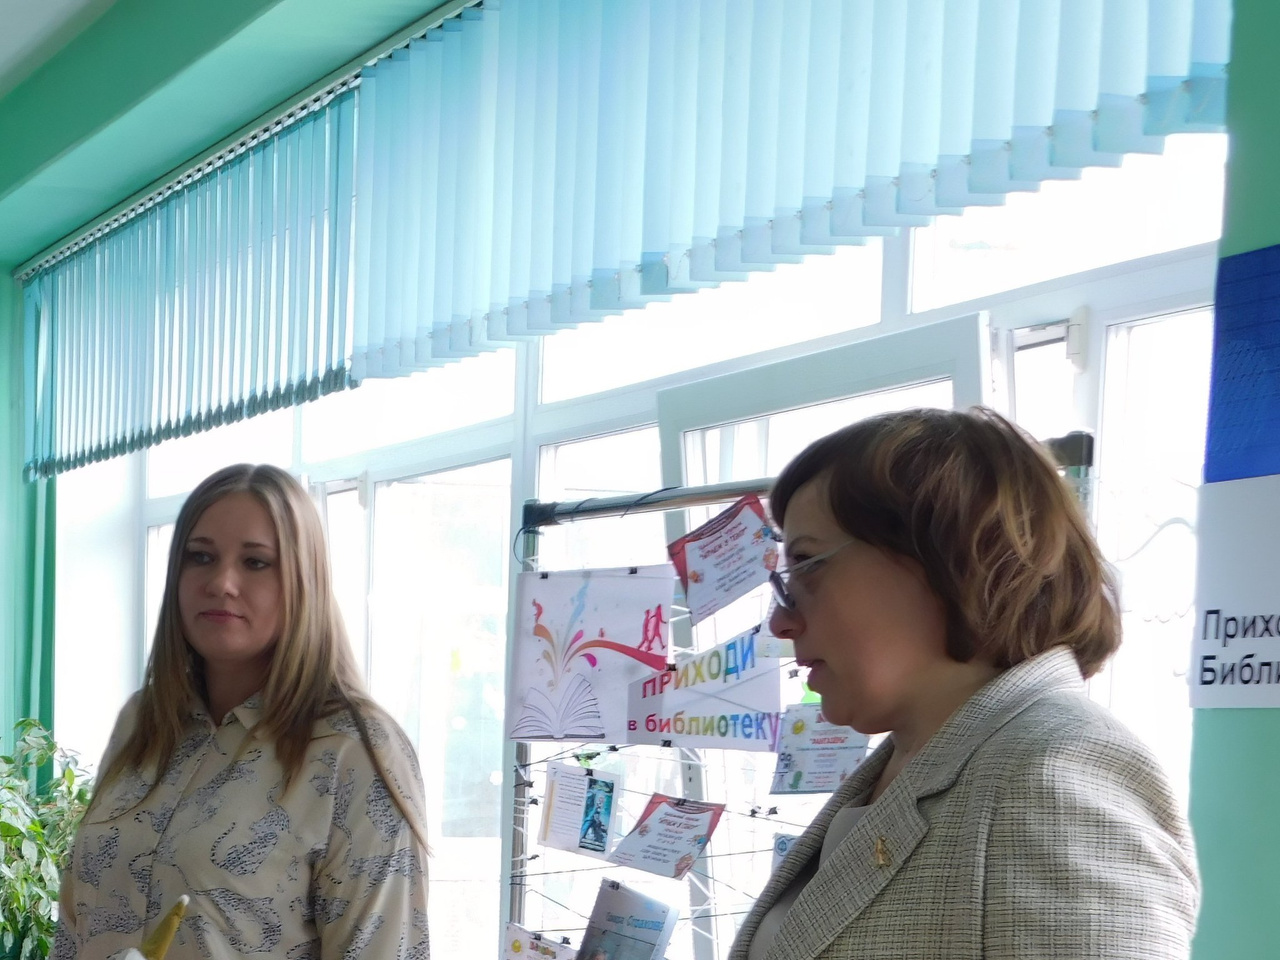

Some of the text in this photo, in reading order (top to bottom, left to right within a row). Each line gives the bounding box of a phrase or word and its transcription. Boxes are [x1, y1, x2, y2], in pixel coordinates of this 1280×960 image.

[1202, 609, 1280, 648] Прих
[641, 633, 756, 699] ПРИХОДИ
[627, 719, 638, 731] в
[644, 710, 780, 752] библиотеку
